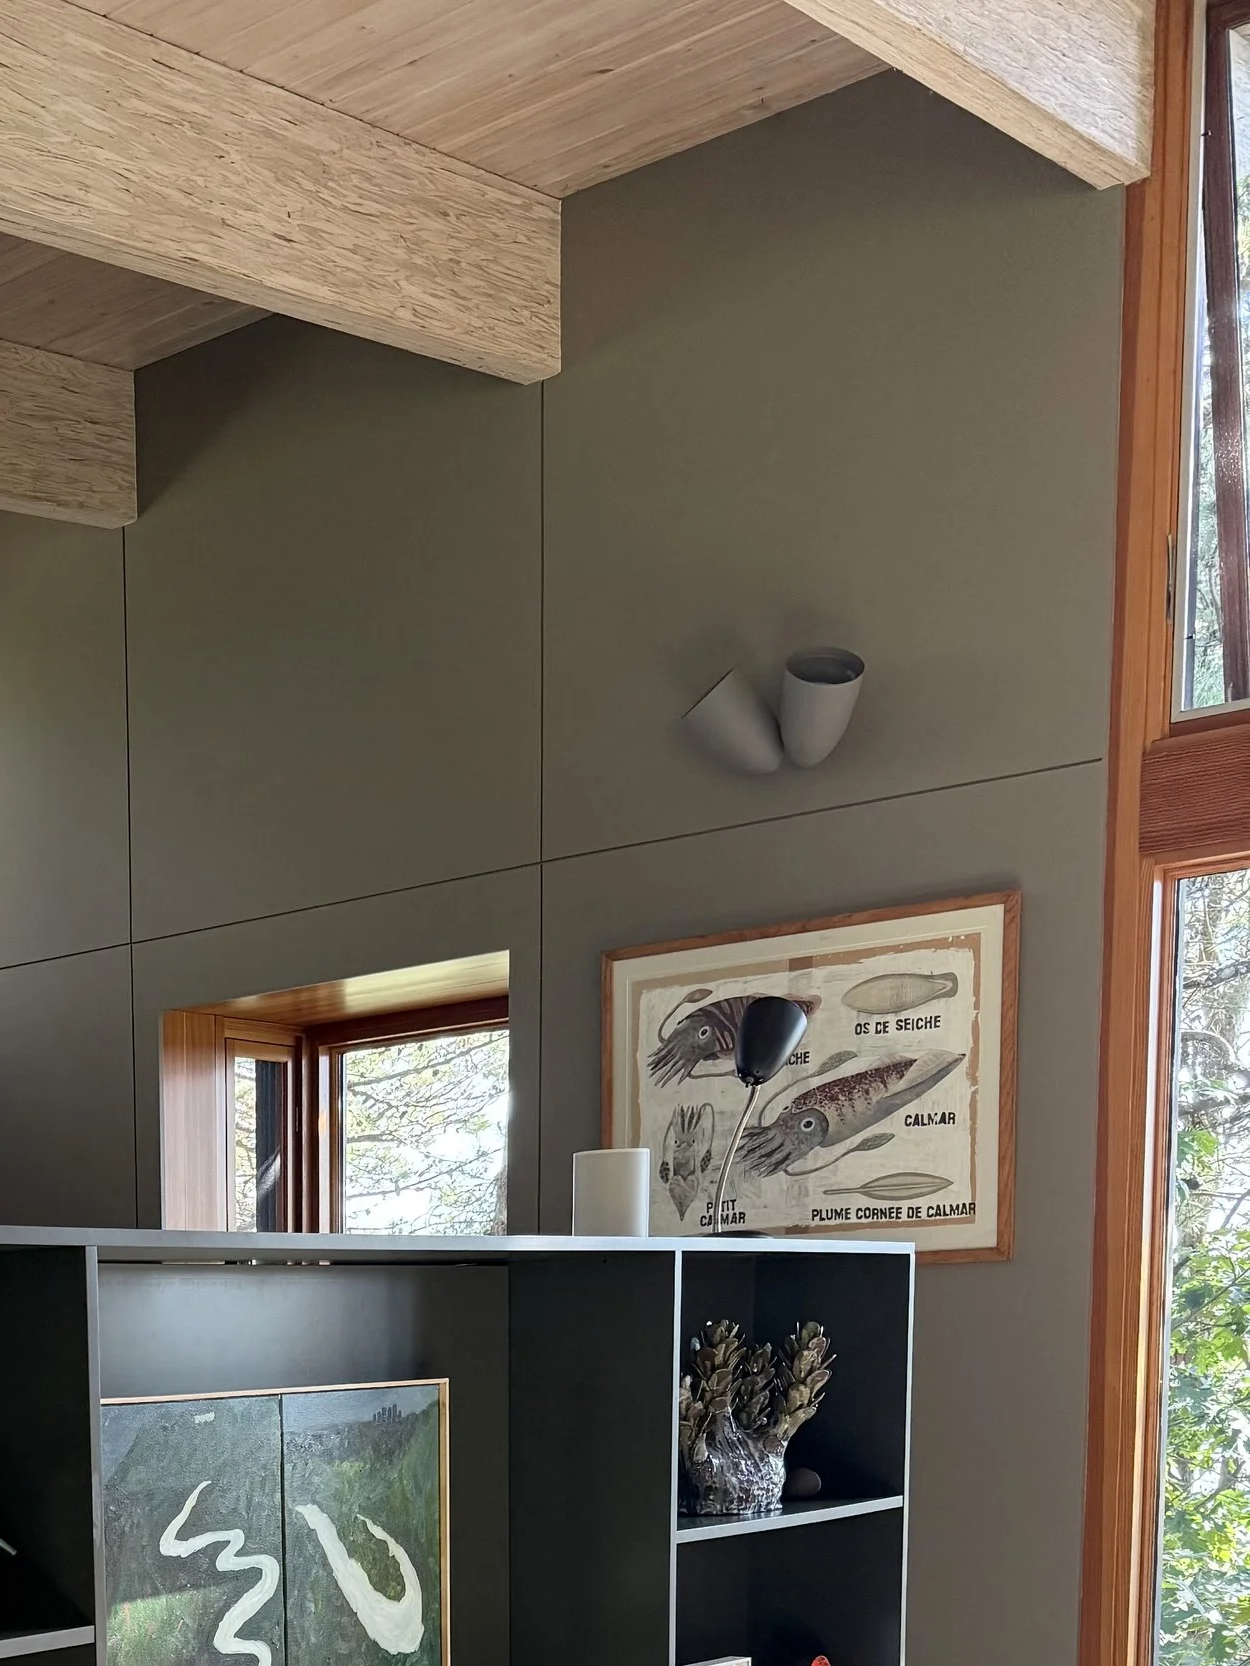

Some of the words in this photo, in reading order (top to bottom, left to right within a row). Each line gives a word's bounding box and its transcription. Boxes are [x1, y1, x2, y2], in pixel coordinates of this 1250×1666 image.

[854, 1020, 870, 1036] OS
[875, 1019, 890, 1035] DE
[895, 1015, 942, 1032] SEICHE
[786, 1051, 810, 1066] CHE
[904, 1110, 956, 1128] CALMAR
[706, 1198, 737, 1214] PTIT
[811, 1207, 853, 1223] PLUME
[856, 1205, 902, 1220] CORNEE
[907, 1204, 922, 1219] DE
[926, 1201, 976, 1218] CALMAR
[700, 1211, 746, 1227] CAMAR
